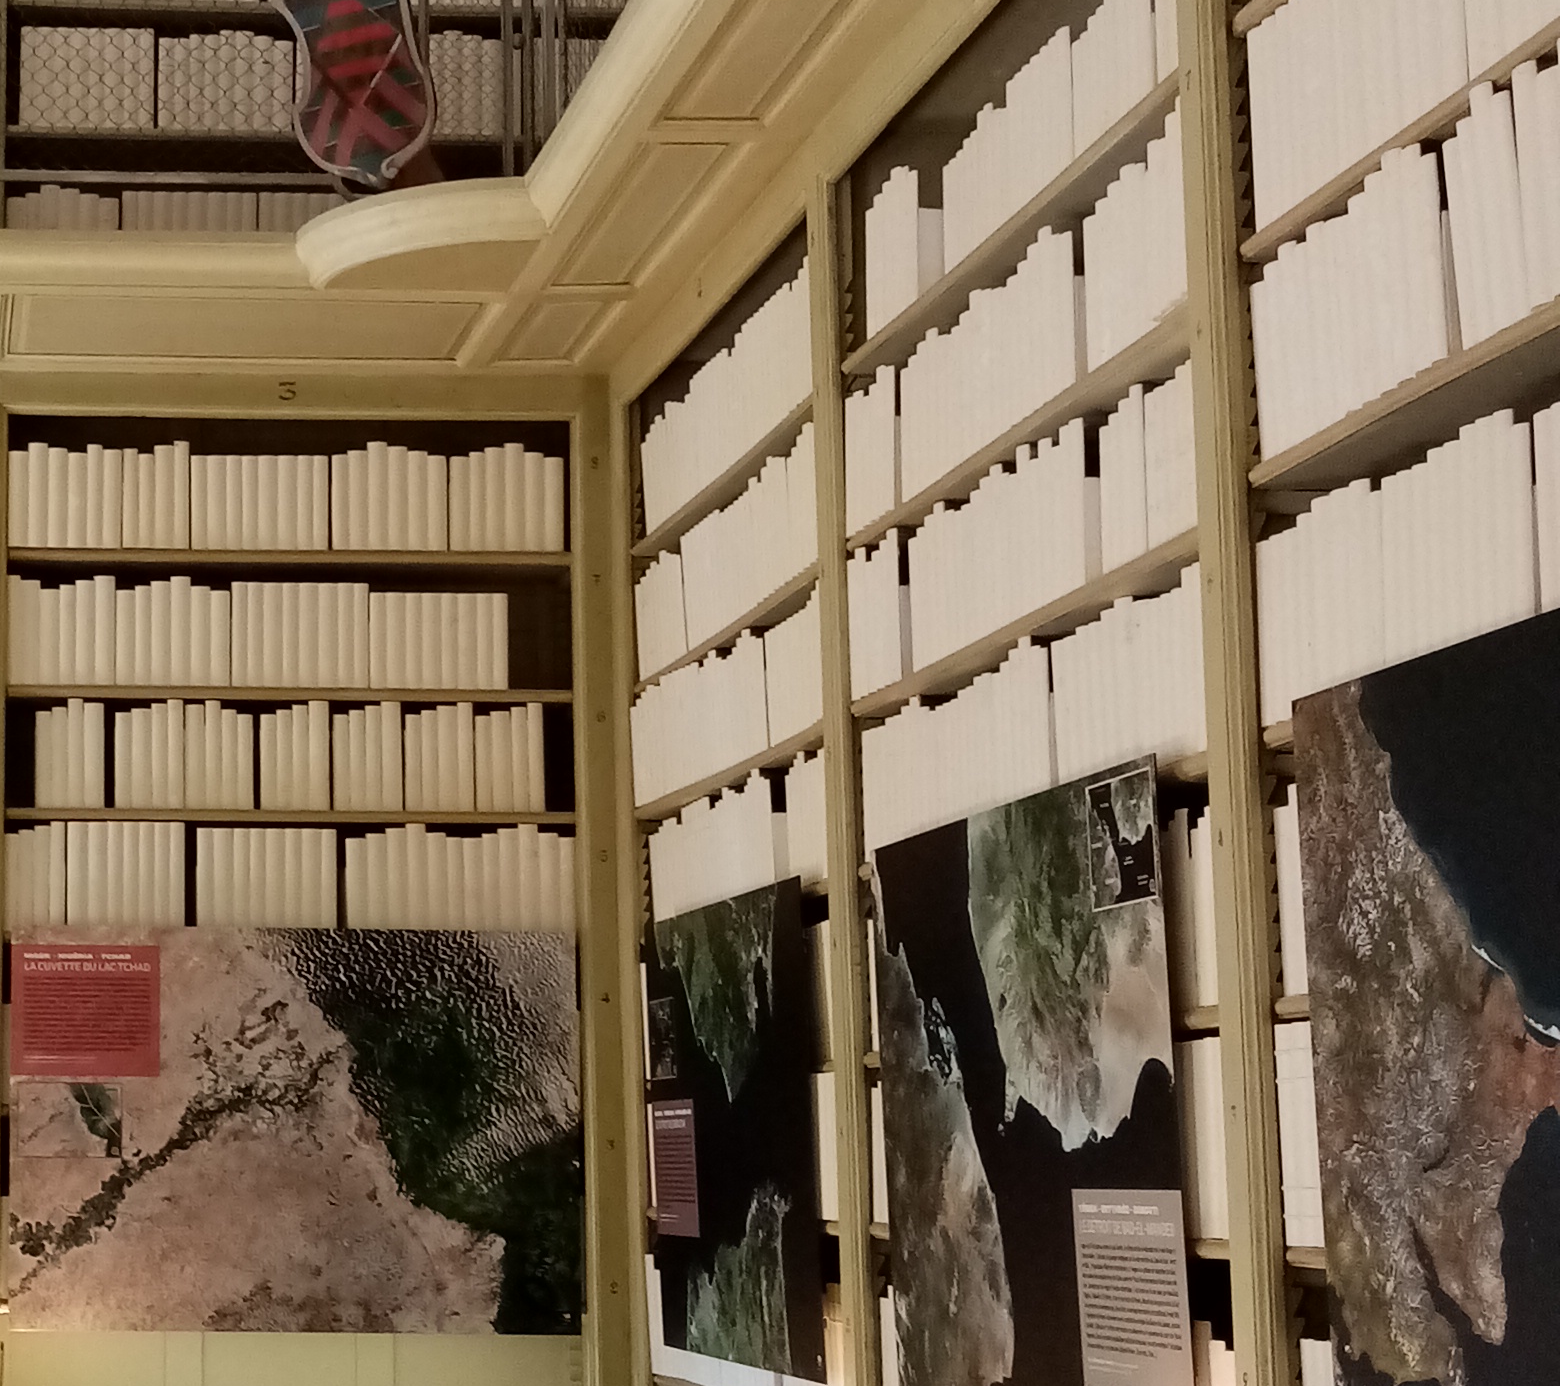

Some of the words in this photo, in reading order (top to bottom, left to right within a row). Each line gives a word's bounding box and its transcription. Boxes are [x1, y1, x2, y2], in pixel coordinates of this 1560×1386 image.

[24, 961, 37, 971] LA
[38, 961, 81, 971] CUVETTE
[82, 962, 97, 972] DU
[98, 962, 117, 972] LAC
[118, 962, 152, 973] TCHAD
